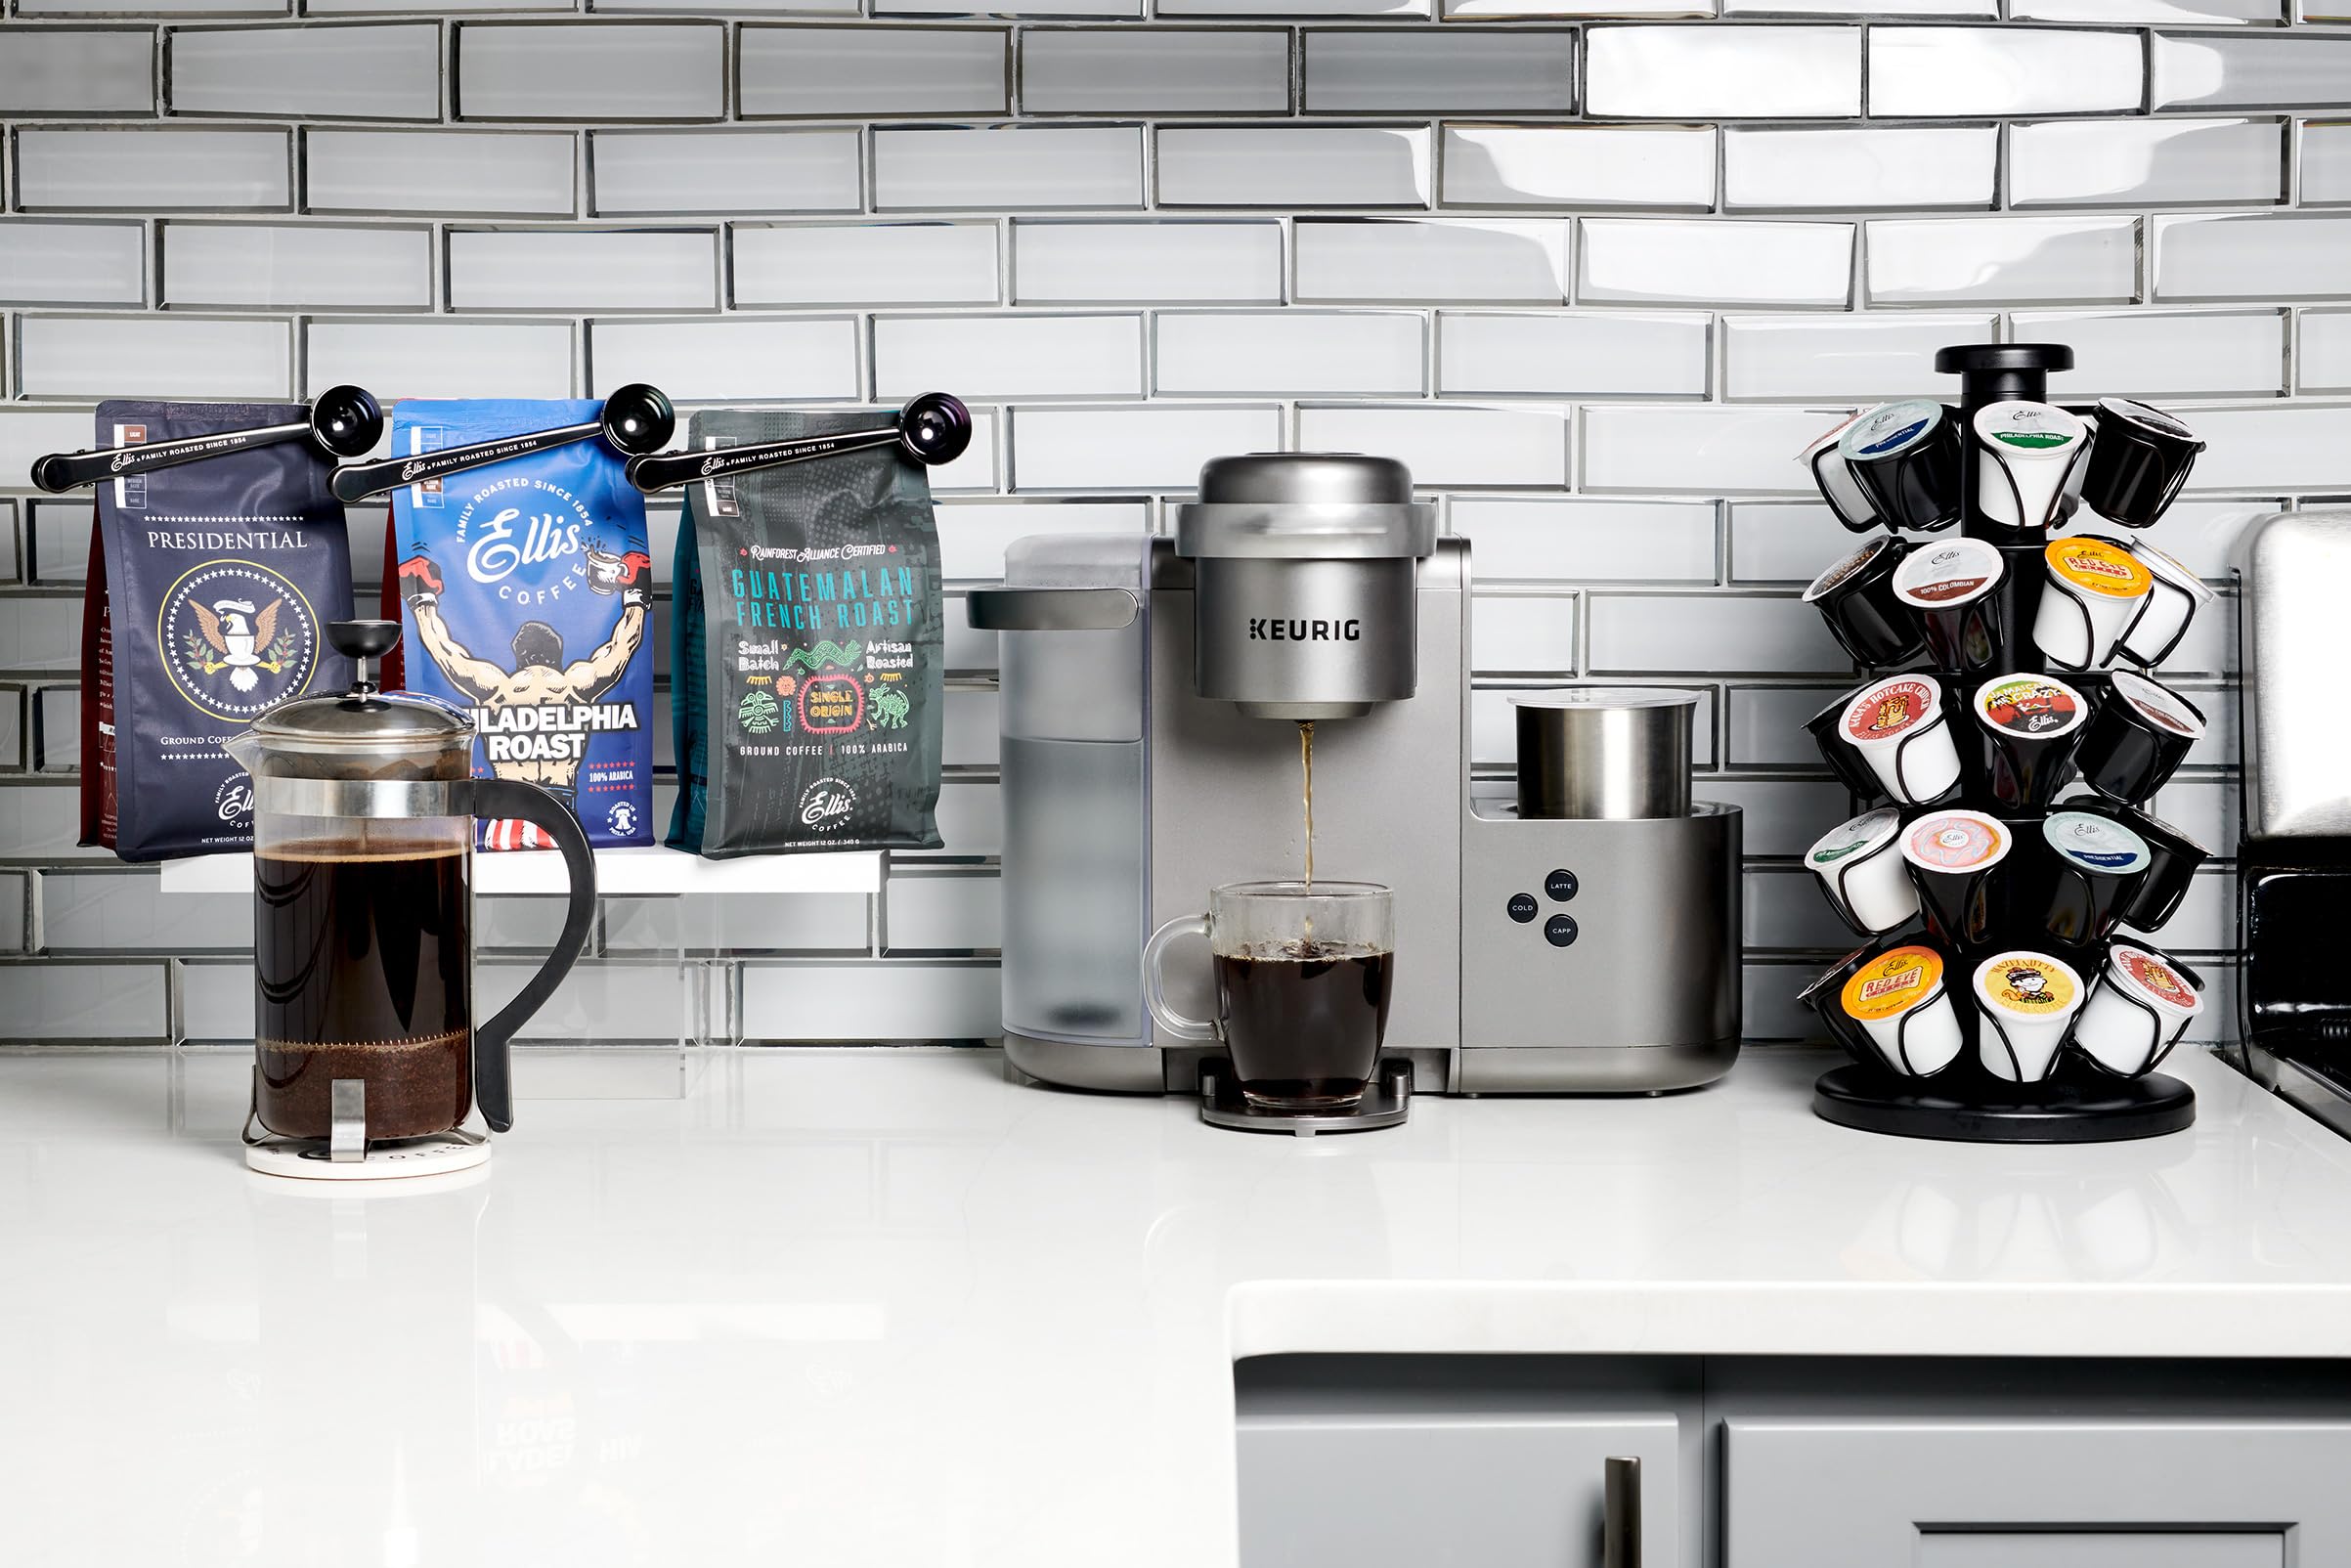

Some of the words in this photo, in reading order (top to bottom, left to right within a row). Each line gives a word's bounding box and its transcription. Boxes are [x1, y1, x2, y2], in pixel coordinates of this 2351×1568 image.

[110, 452, 136, 472] Ellis
[141, 452, 167, 461] FAMILY
[169, 444, 204, 457] ROASTED
[205, 440, 229, 450] SINCE
[401, 460, 426, 481] Ellis
[431, 457, 458, 469] FAMILY
[459, 449, 495, 462] ROASTED
[497, 442, 519, 455] SINCE
[700, 457, 725, 476] Ellis
[730, 455, 757, 465] FAMILY
[759, 449, 793, 460] ROASTED
[795, 445, 817, 455] SINCE
[818, 442, 835, 451] 1854
[456, 502, 475, 544] FAMILY
[473, 477, 530, 503] ROASTED
[534, 479, 573, 501] SINCE
[572, 500, 593, 527] 1854
[147, 530, 308, 550] PRESIDENTIAL
[499, 563, 588, 605] COFFEE
[732, 566, 913, 602] GUATEMALAN
[736, 600, 822, 631] FRENCH
[837, 598, 913, 629] ROAST
[1249, 618, 1361, 641] KEURIG
[738, 639, 779, 655] Small
[865, 639, 912, 654] Artisan
[738, 655, 780, 672] Batch
[865, 654, 914, 670] Roasted
[809, 689, 854, 704] SINGLE
[1868, 683, 1916, 705] HOTCAKE
[2014, 688, 2062, 702] CRAZY
[466, 704, 637, 733] ILADELPHIA
[809, 705, 853, 718] ORIGIN
[160, 736, 205, 746] GROUND
[490, 733, 586, 762] ROAST
[740, 746, 780, 757] GROUND
[786, 745, 823, 756] COFFEE
[841, 744, 865, 755] 100%
[871, 742, 908, 755] ARABICA
[588, 771, 608, 783] 100%
[608, 770, 633, 782] ARABICA
[809, 777, 834, 790] ROASTED
[218, 785, 254, 820] Ell
[811, 814, 851, 832] COFFEE
[2074, 823, 2101, 837] Ellis
[1865, 978, 1892, 993] RED
[1894, 969, 1919, 984] EYE
